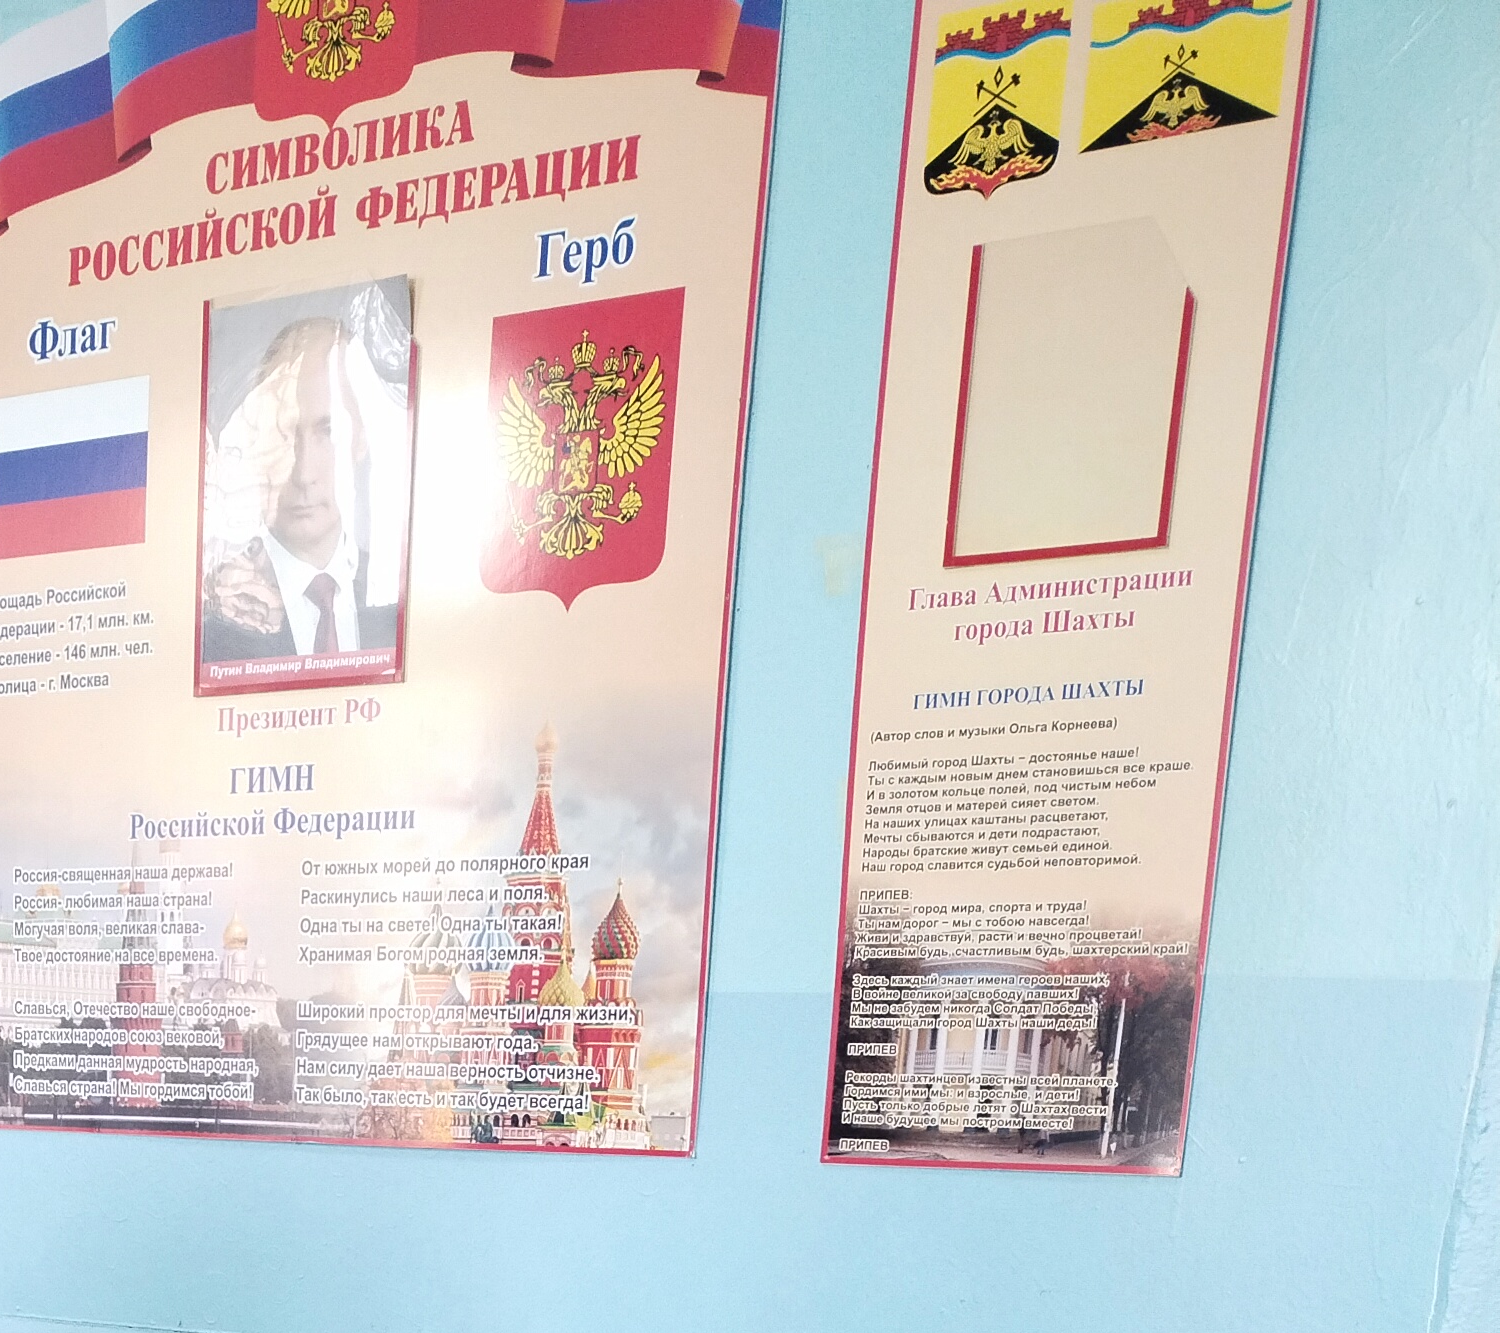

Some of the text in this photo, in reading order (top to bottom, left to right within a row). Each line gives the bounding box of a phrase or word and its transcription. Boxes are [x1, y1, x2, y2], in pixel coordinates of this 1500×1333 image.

[205, 99, 474, 194] СИМВОЛИКА
[68, 134, 641, 286] РОССИЙСКОЙ ФЕДЕРАЦИИ
[534, 217, 635, 284] Герб
[29, 320, 115, 360] Флаг
[46, 581, 125, 604] Российской
[908, 569, 1192, 610] Глава Администрации
[67, 614, 92, 632] 17,1
[97, 614, 128, 628] млн.
[133, 612, 153, 625] км.
[954, 610, 1135, 644] города Шахты
[64, 643, 86, 660] 146
[90, 644, 120, 658] млн.
[125, 642, 152, 654] чел.
[209, 653, 390, 679] Путин Владимир Владимирович
[48, 679, 55, 690] г.
[60, 673, 108, 689] Москва
[913, 678, 1143, 709] ГИМН ГОРОДА ШАХТЫ
[218, 697, 380, 737] Президент РФ
[870, 716, 1117, 744] (Автор слов и музыки Ольга Корнеева)
[867, 758, 928, 771] Любимый
[931, 758, 967, 769] город
[971, 754, 1014, 766] Шахты
[1028, 751, 1097, 764] достоянье
[1101, 746, 1139, 759] наше!
[229, 763, 314, 794] ГИМН
[867, 760, 1193, 785] Ты с каждым новым днем становишься все краше.
[130, 807, 414, 841] Российской Федерации
[14, 863, 232, 883] Россия-священная наша держава!
[301, 854, 588, 876] От южных морей до полярного края
[14, 891, 211, 909] Россия- любимая наша страна!
[301, 886, 547, 907] Раскинулись наши леса и поля.
[14, 922, 204, 939] Могучая воля, великая слава-
[14, 949, 218, 965] Твое достояние на все времена.
